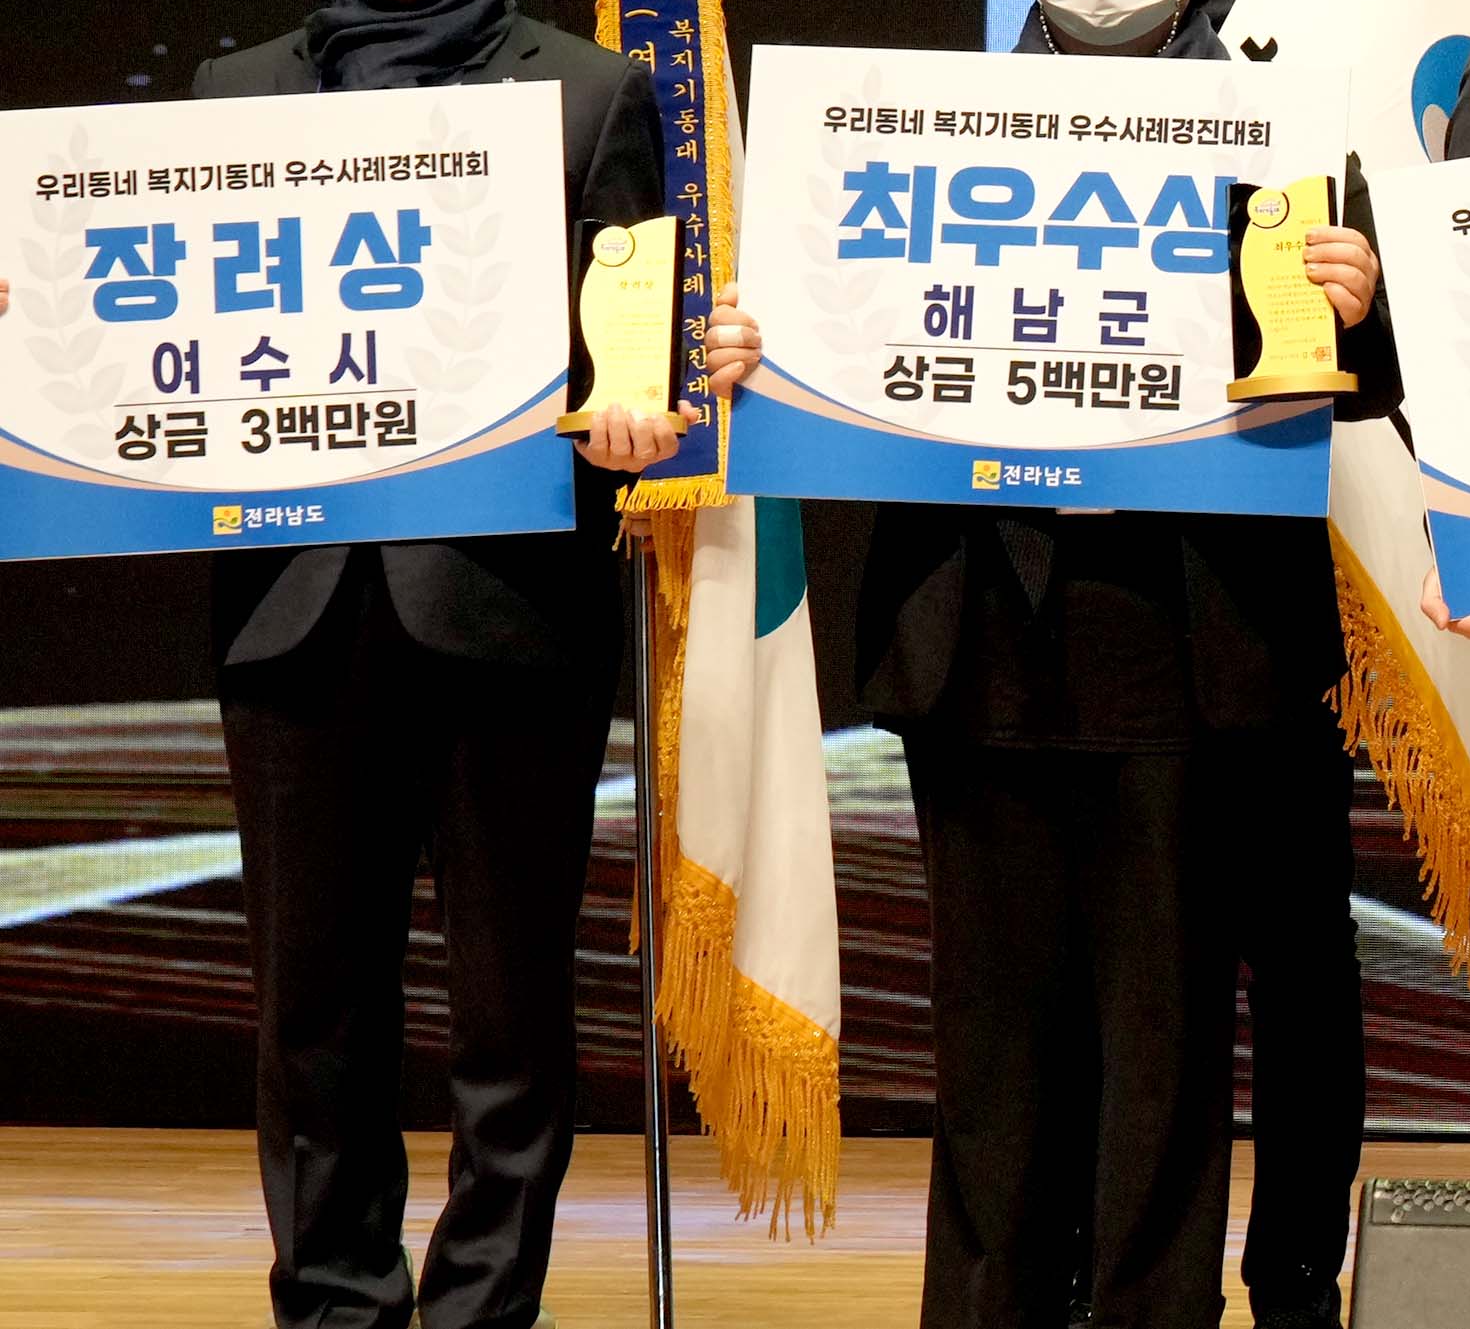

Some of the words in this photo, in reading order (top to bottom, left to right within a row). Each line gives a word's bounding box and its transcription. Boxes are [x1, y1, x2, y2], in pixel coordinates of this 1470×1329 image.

[669, 18, 700, 164] 복지기동대
[823, 106, 924, 136] 우리동네
[933, 109, 1060, 140] 복지기동대
[1068, 114, 1272, 148] 우수사례경진대회
[36, 169, 138, 201] 우리동네
[147, 161, 275, 195] 복지기동대
[284, 150, 489, 187] 우수사례경진대회
[676, 183, 707, 297] 우수사례
[837, 162, 1238, 274] 최우수상
[84, 208, 432, 323] 장려상
[923, 284, 1149, 347] 해남군
[152, 329, 377, 395] 여수시
[884, 355, 976, 403] 상금
[1006, 360, 1182, 411] 5백만원
[115, 411, 209, 461] 상금
[241, 399, 417, 455] 3백만원
[1002, 464, 1083, 487] 전라남도
[244, 504, 325, 528] 전라남도
